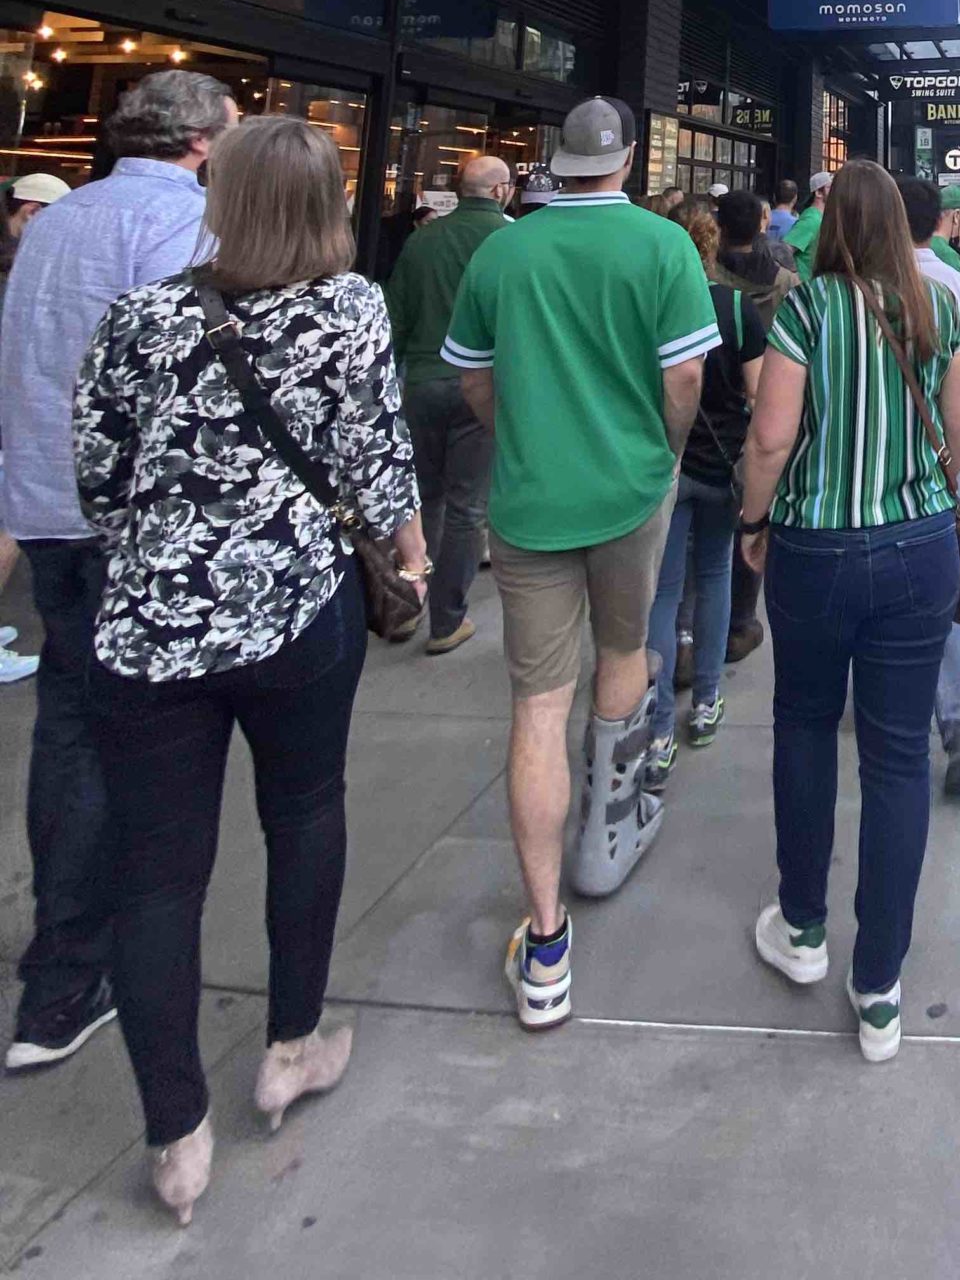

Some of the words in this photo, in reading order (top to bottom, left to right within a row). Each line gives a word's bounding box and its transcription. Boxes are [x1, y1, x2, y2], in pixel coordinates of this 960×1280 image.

[819, 3, 906, 15] momosan
[911, 89, 935, 97] SWING
[936, 88, 955, 96] SUITE
